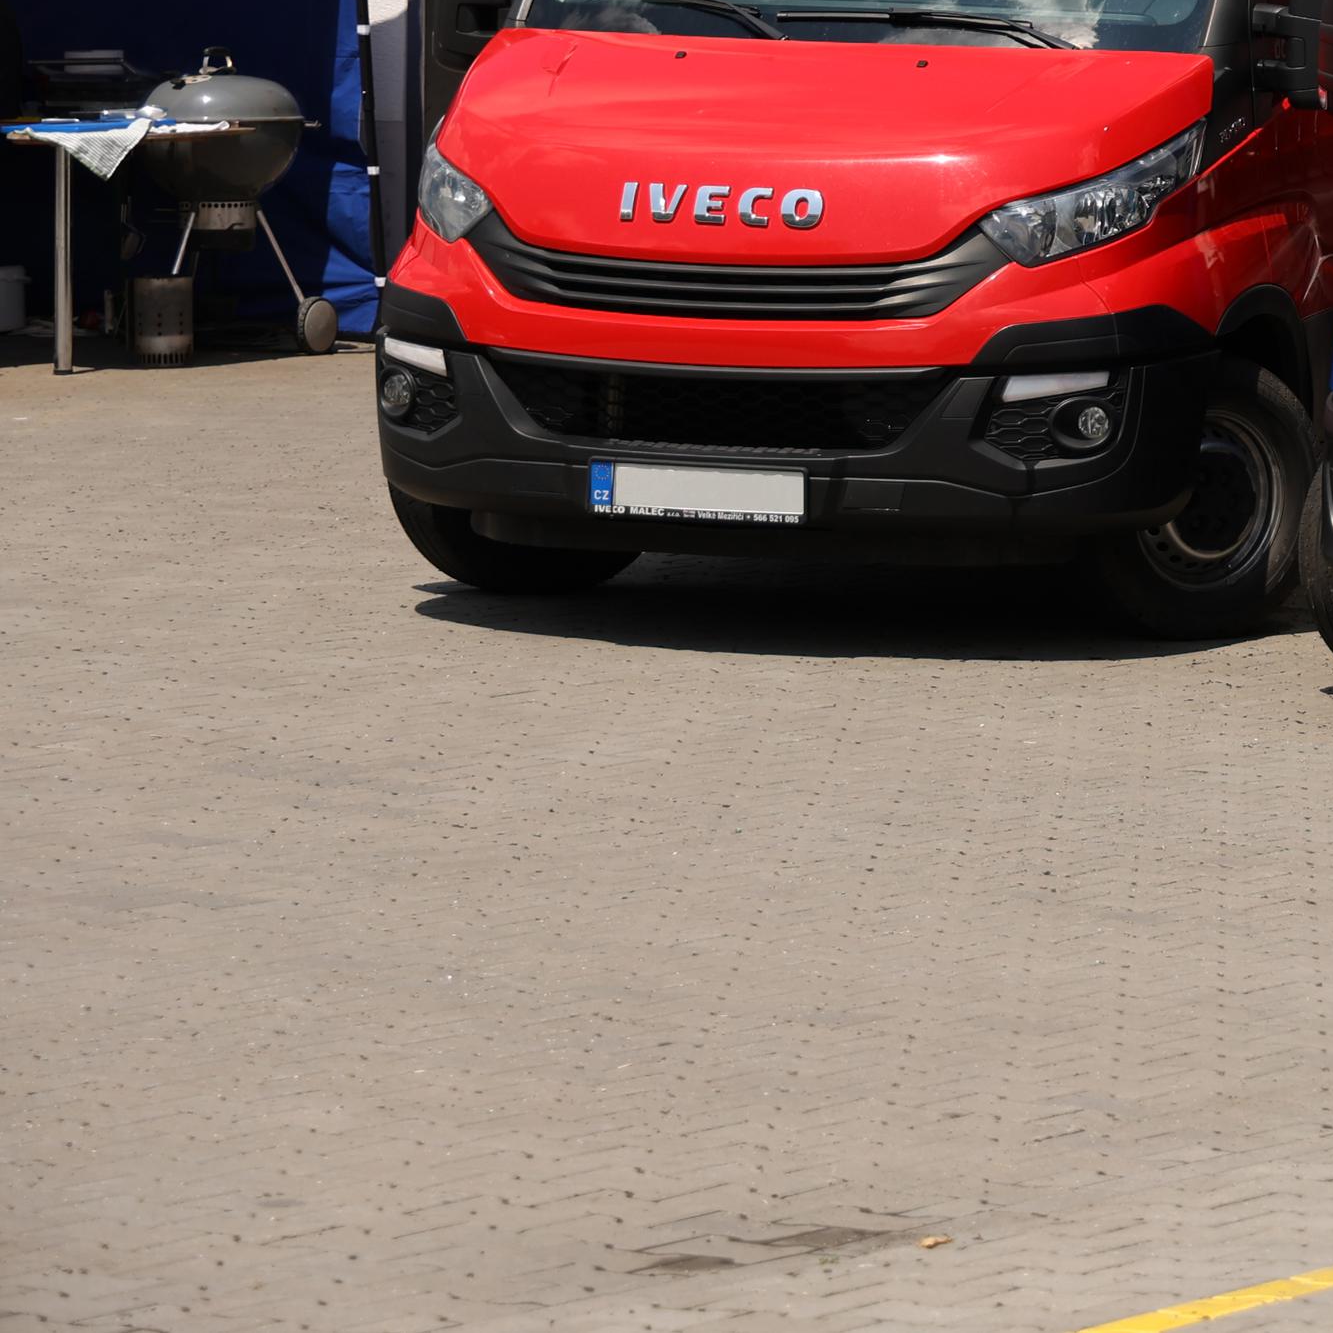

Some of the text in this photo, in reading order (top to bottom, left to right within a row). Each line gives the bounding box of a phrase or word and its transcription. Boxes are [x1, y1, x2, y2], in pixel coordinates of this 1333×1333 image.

[620, 181, 824, 228] IVECO
[594, 489, 609, 500] CZ
[594, 504, 626, 514] IVECO
[630, 506, 664, 517] MALEC
[753, 513, 768, 521] 566
[784, 515, 799, 523] 095
